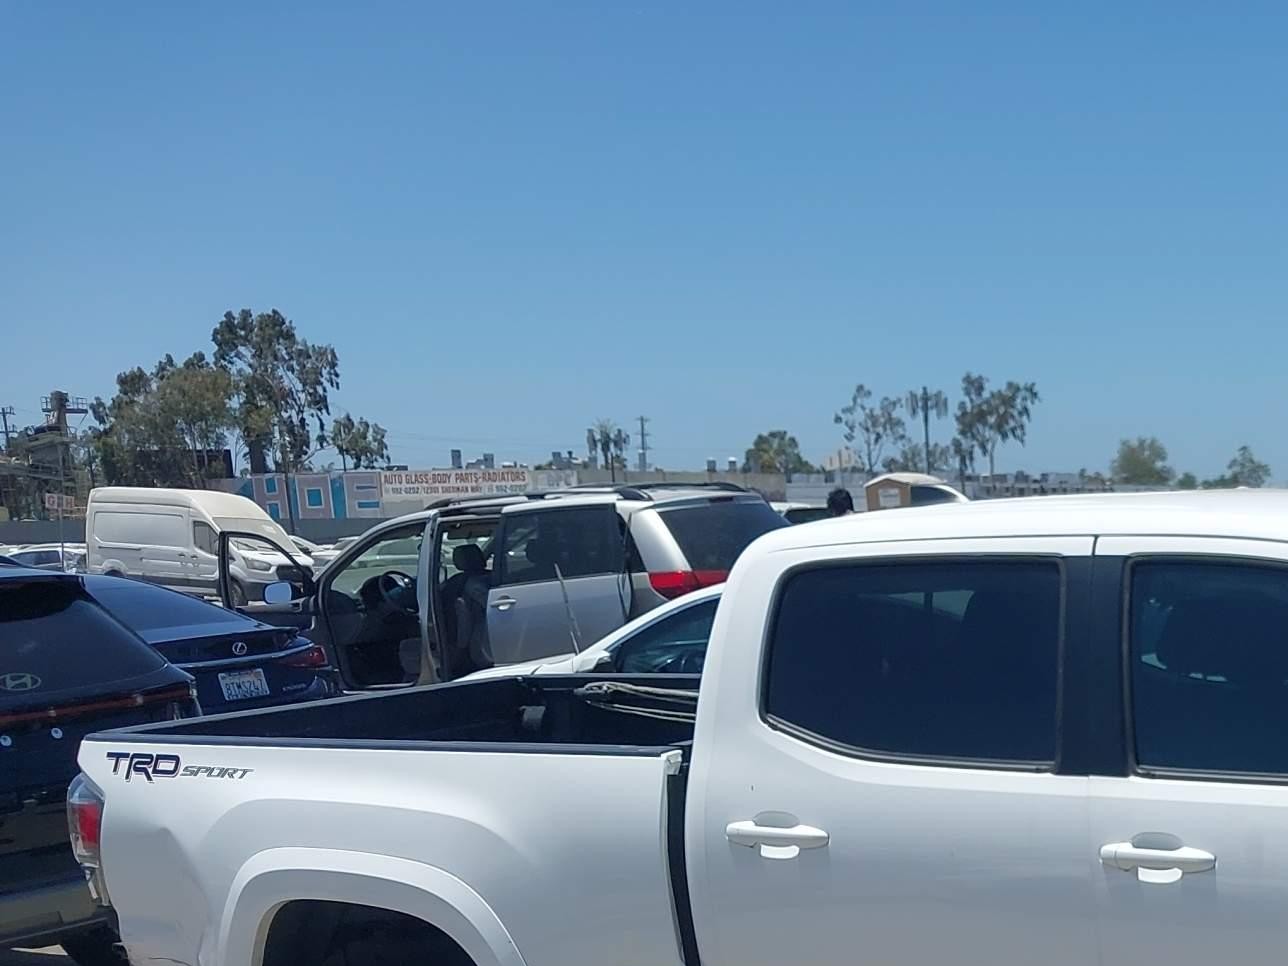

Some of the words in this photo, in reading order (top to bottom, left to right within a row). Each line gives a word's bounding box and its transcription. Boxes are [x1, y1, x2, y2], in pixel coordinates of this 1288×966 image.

[384, 473, 403, 485] AUTO
[106, 752, 182, 783] TRD
[180, 765, 255, 780] SPORT
